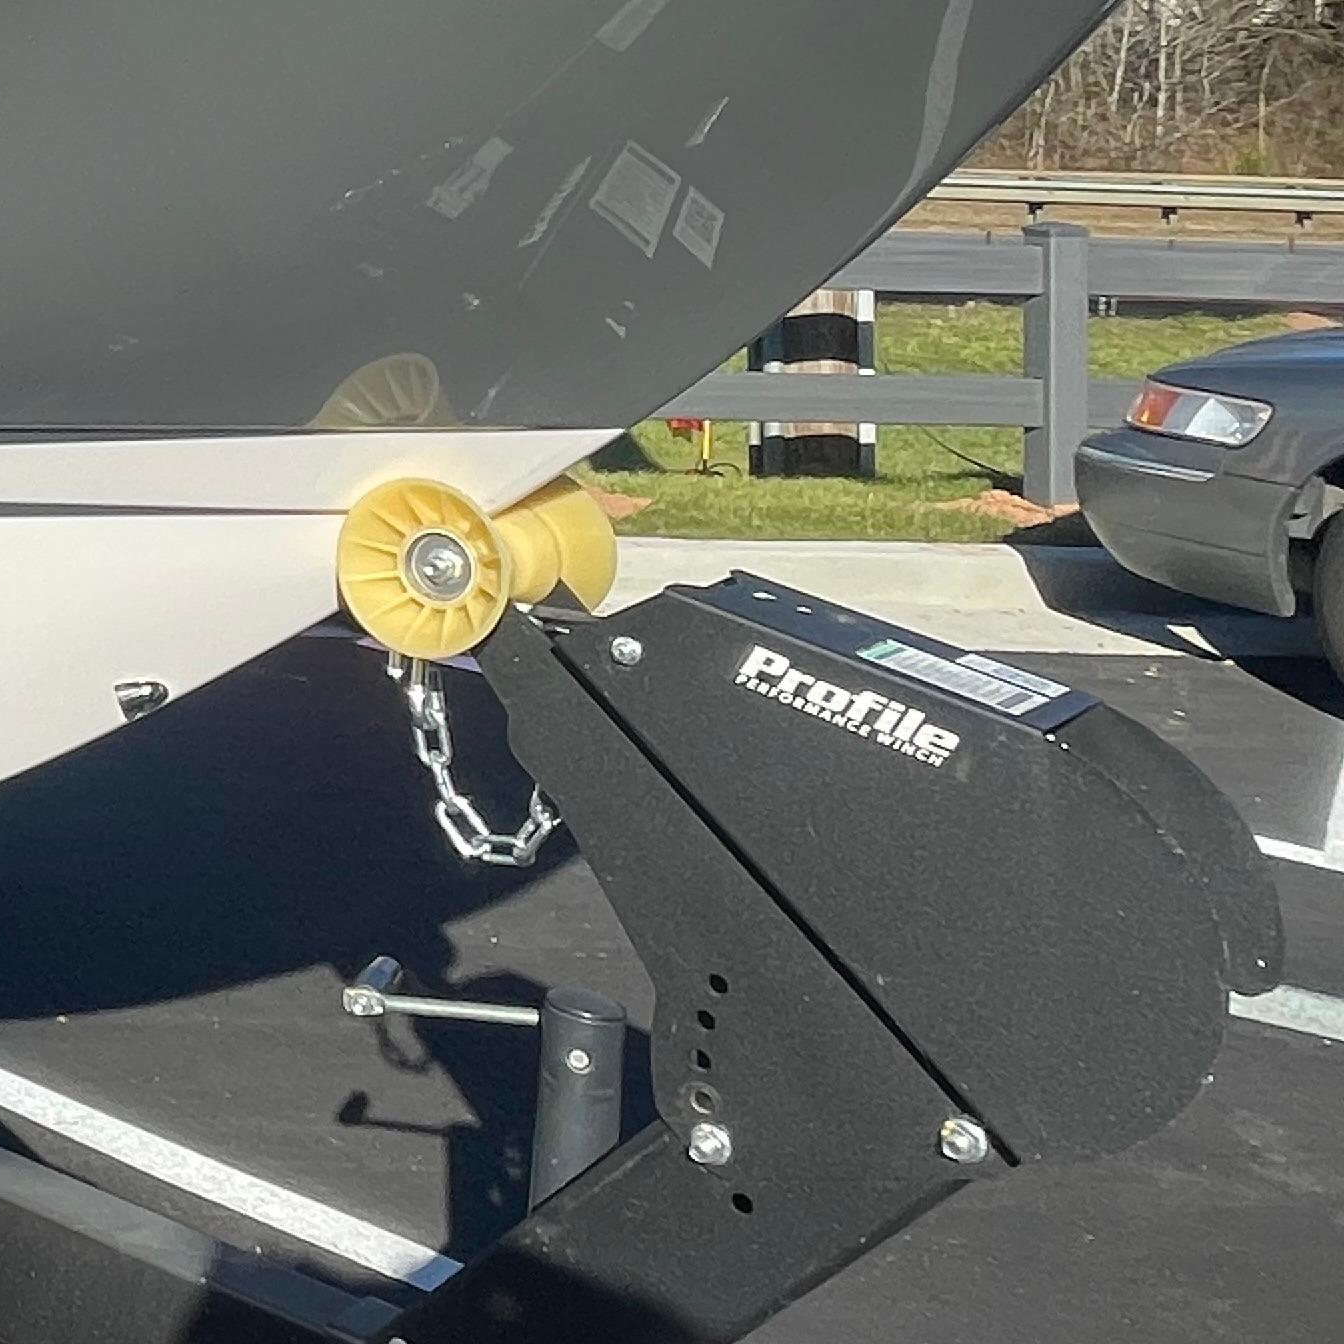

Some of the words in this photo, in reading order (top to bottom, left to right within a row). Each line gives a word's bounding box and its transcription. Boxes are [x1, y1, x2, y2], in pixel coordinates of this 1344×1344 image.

[734, 673, 872, 738] PERFORMANCE
[876, 731, 944, 768] WINCH
[738, 644, 960, 757] Profile
